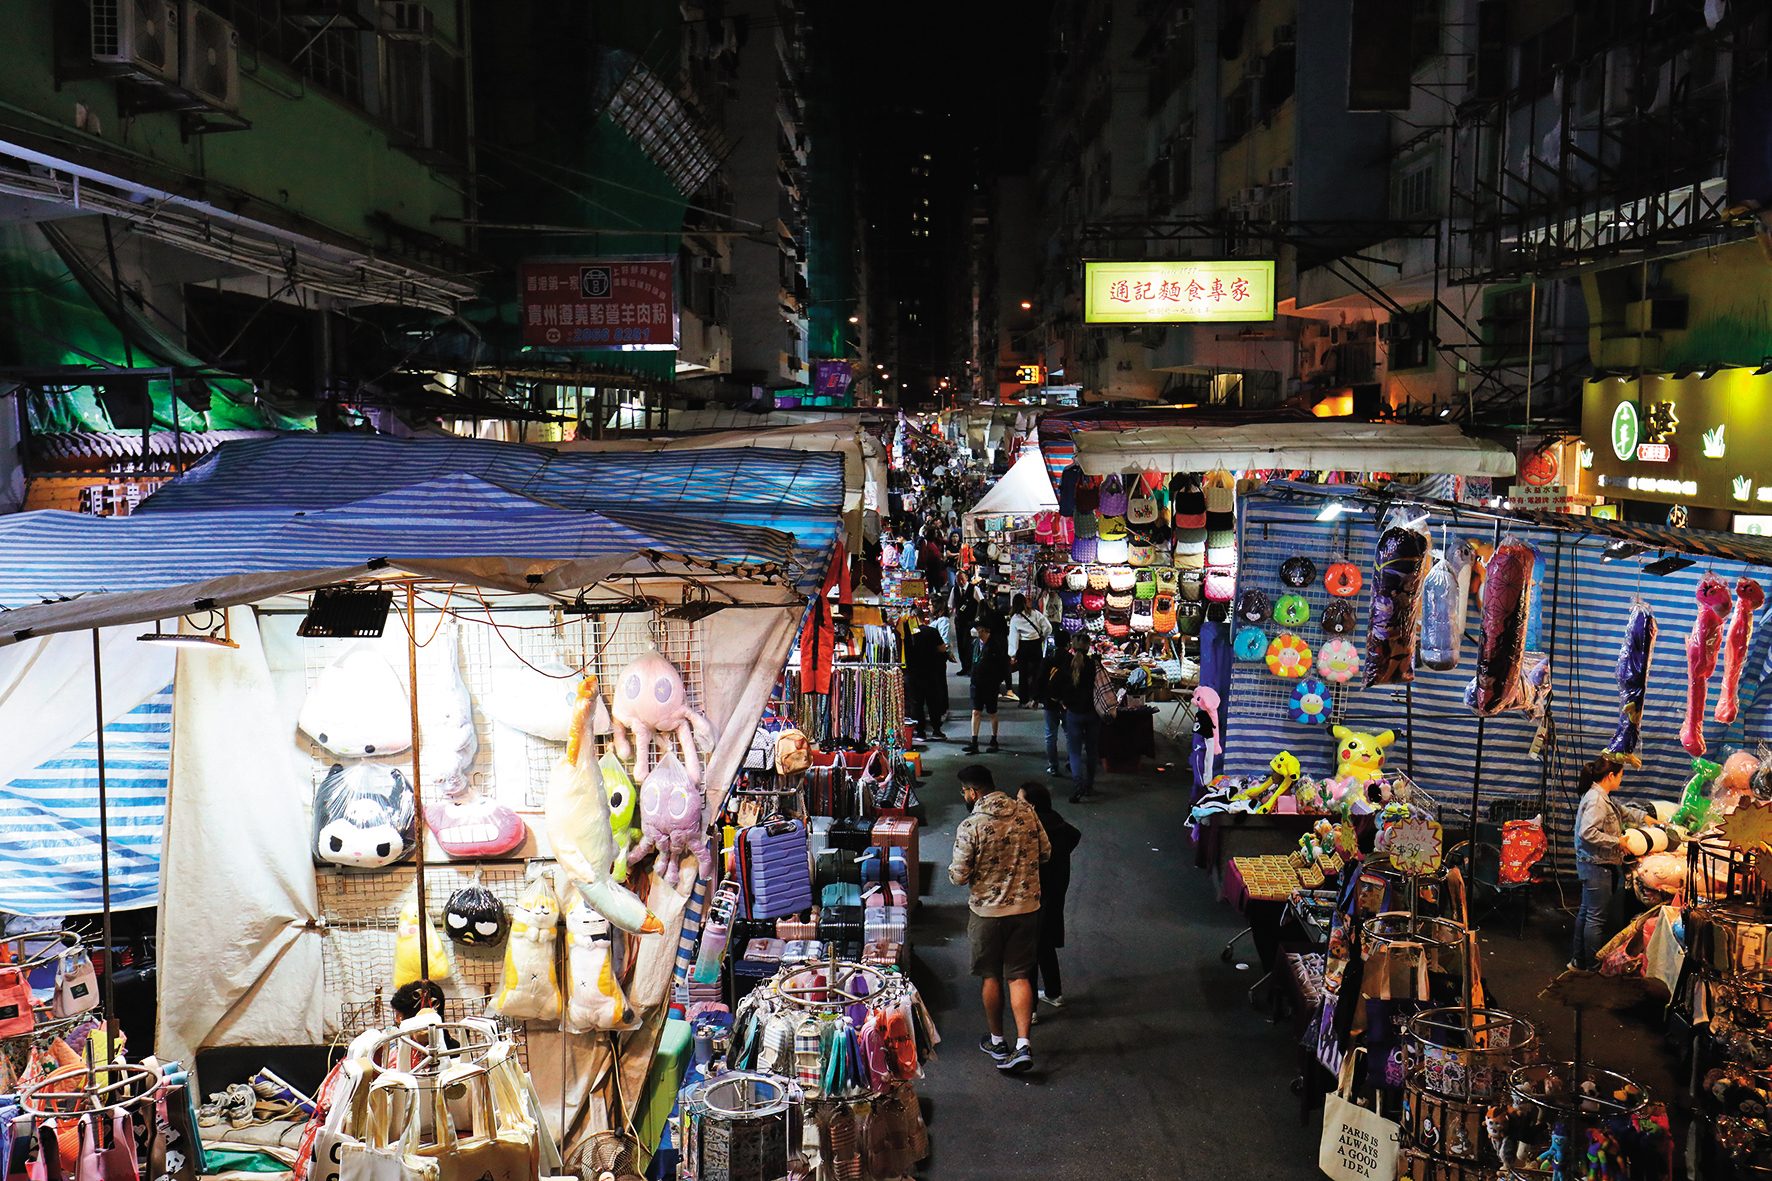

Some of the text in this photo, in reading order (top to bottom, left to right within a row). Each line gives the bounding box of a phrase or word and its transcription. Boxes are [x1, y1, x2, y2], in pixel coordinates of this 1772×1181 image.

[528, 275, 580, 291] 香港第一家
[1109, 277, 1251, 303] 通記麵食專家
[614, 328, 651, 342] 8281
[1397, 842, 1421, 859] $39
[1341, 1123, 1379, 1147] PARIS IS
[1337, 1145, 1377, 1170] A GOOD
[1338, 1134, 1379, 1159] ALWAYS
[1342, 1158, 1370, 1178] IDEA
